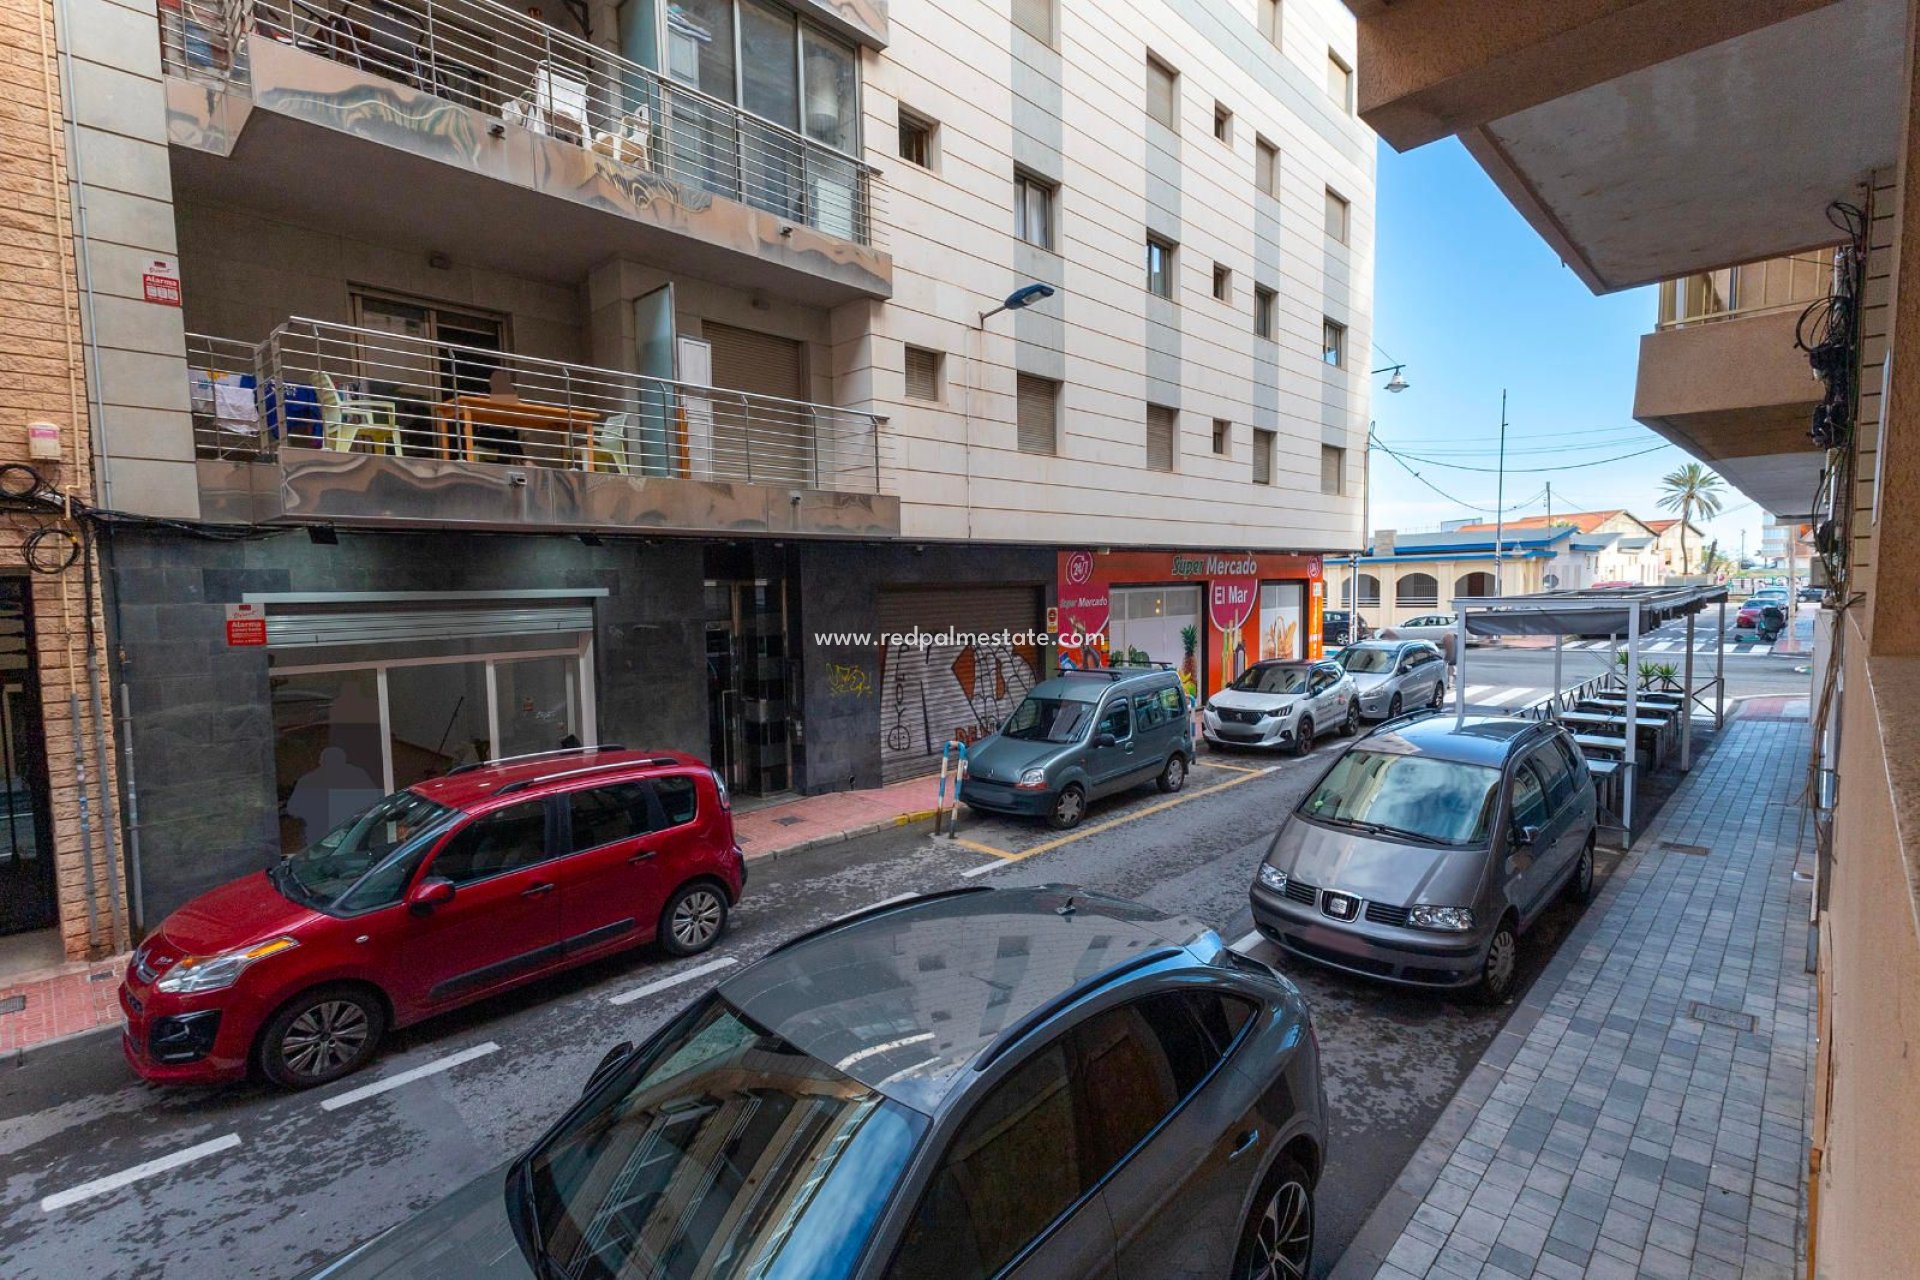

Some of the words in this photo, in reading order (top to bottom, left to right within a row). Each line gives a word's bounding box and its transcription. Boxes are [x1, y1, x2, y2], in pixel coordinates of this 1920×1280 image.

[1171, 555, 1204, 580] Super
[1206, 555, 1257, 575] Mercado
[1078, 595, 1108, 607] Mercado
[1214, 586, 1225, 605] El
[1228, 585, 1248, 604] Mar
